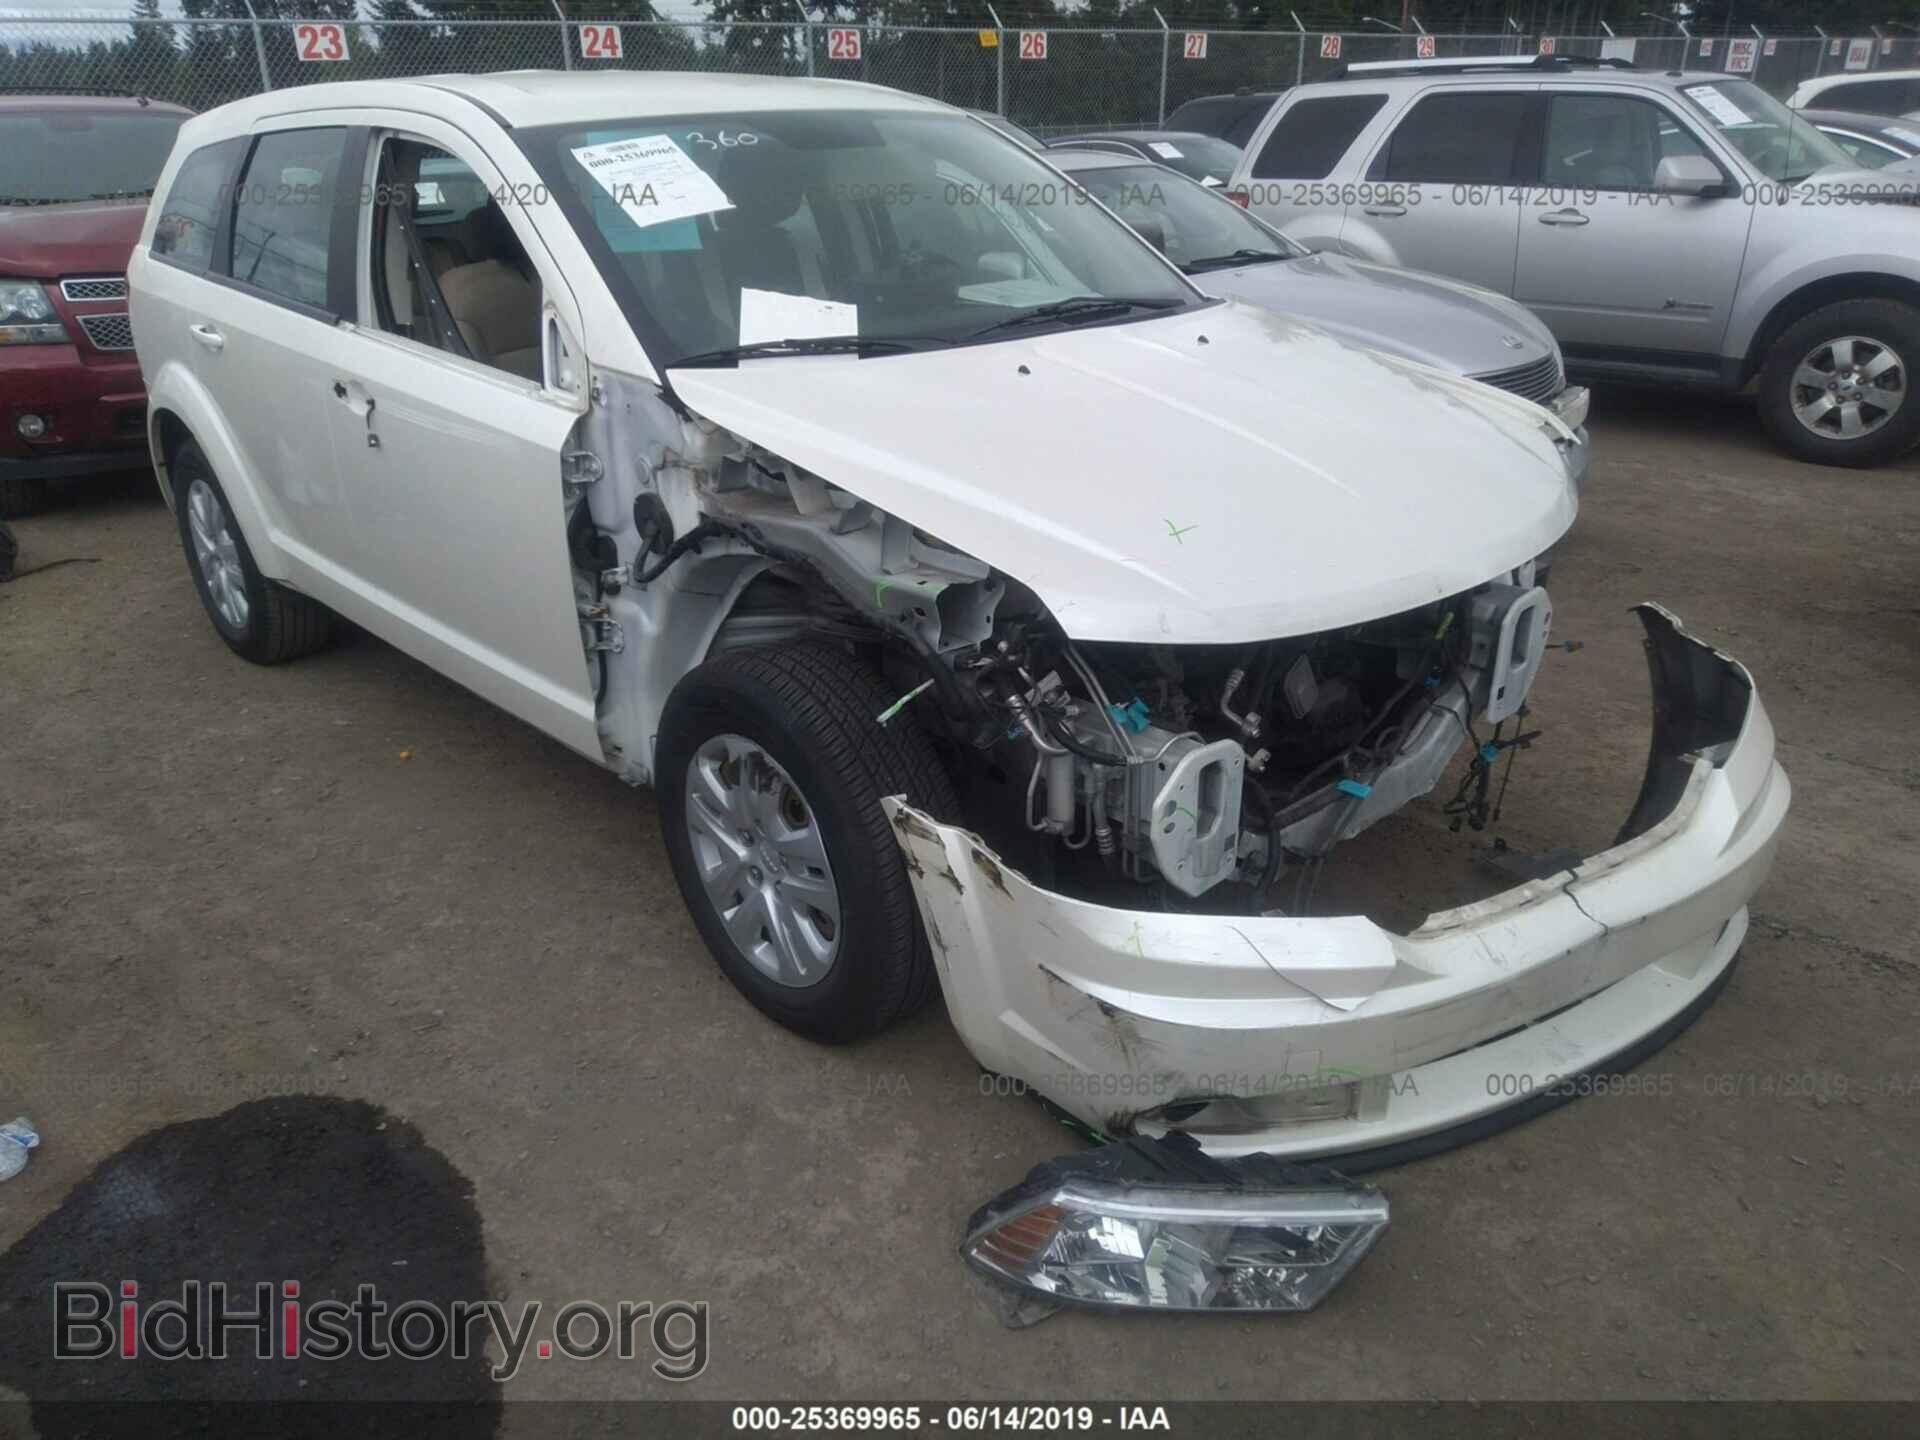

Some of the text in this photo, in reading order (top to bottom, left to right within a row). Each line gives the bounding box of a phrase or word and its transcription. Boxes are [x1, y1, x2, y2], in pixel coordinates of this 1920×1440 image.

[297, 25, 344, 60] 23
[583, 25, 619, 57] 24
[831, 30, 858, 58] 25
[1022, 32, 1045, 57] 26
[1186, 34, 1206, 57] 27
[1323, 36, 1339, 57] 28
[1418, 38, 1434, 57] 29
[686, 130, 759, 150] 360
